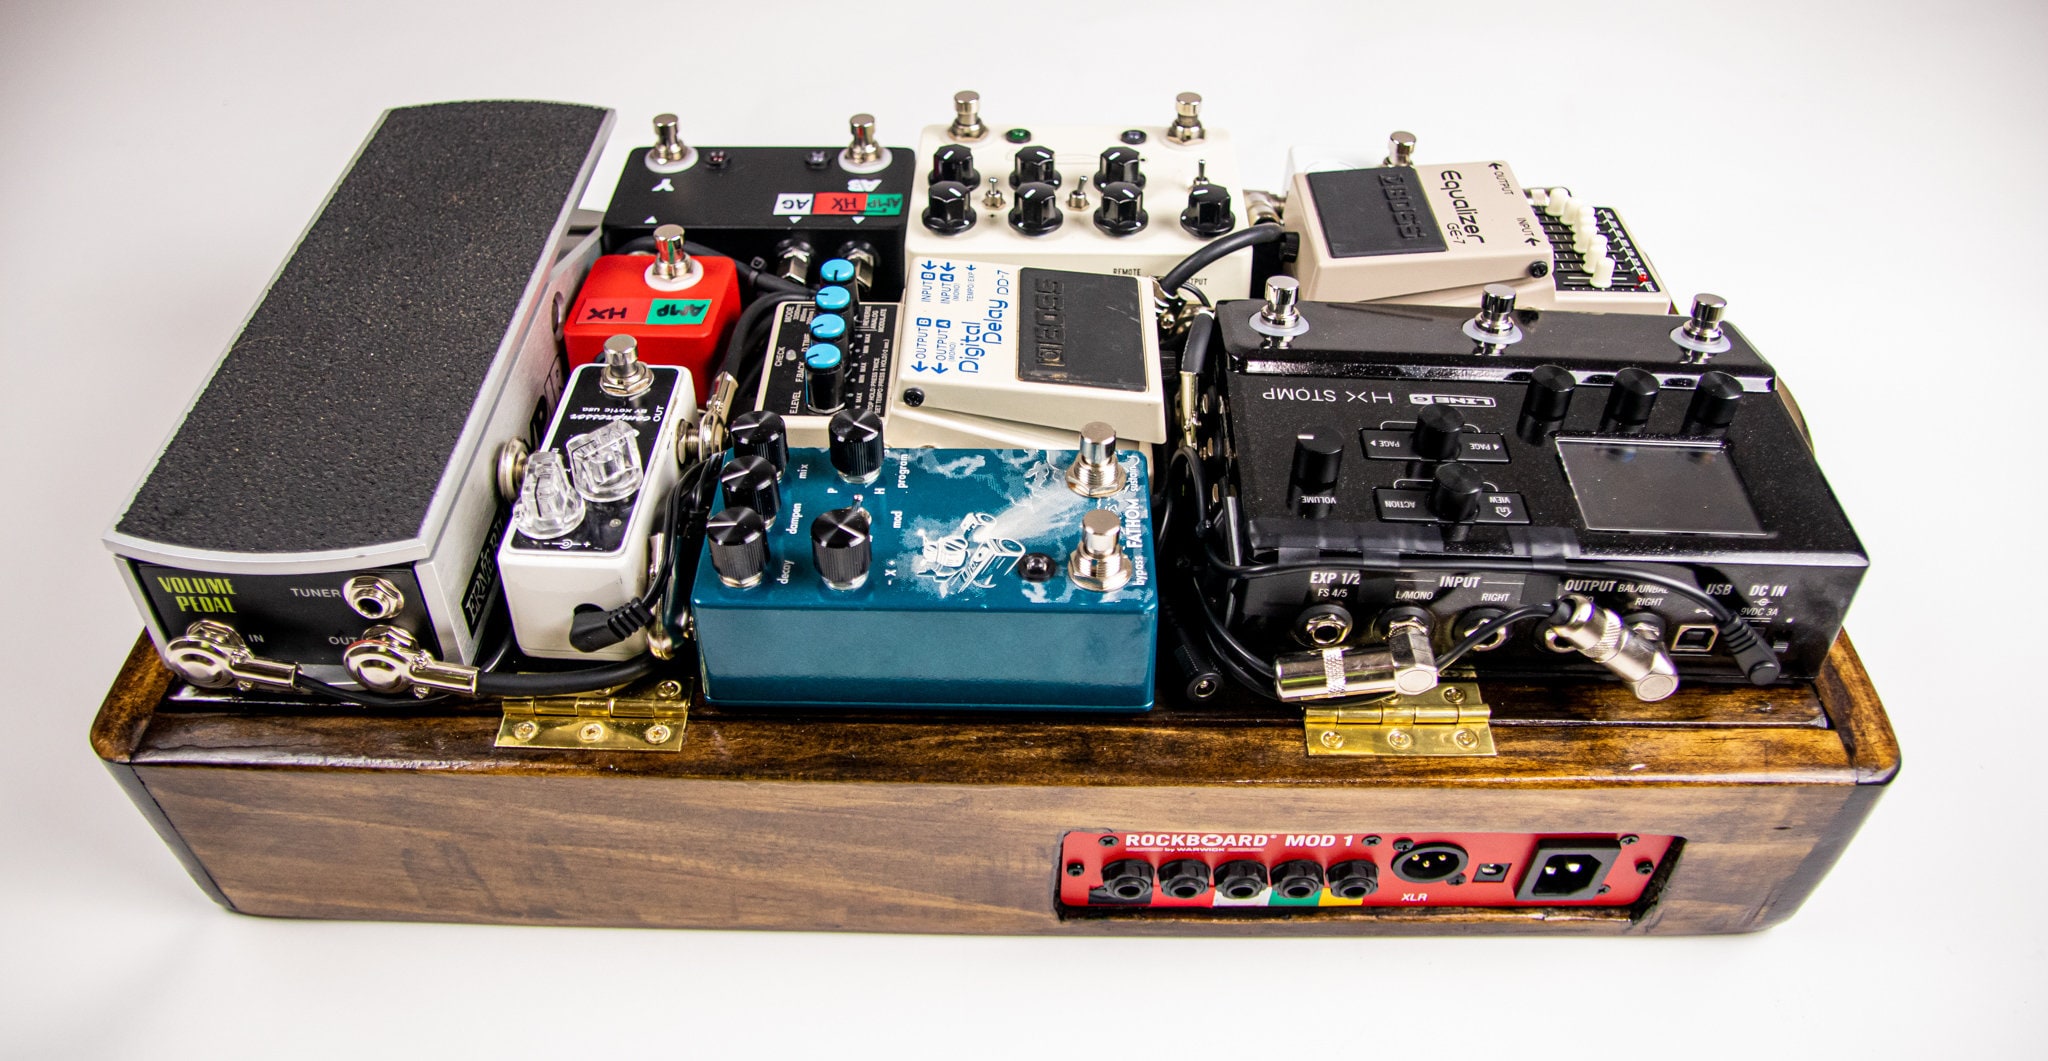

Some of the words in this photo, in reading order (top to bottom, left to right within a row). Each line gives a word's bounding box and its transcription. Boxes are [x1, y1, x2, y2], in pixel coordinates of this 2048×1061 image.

[651, 178, 675, 192] Y
[847, 178, 882, 192] AB
[1493, 170, 1514, 196] OUTPUT
[782, 198, 811, 210] AG
[831, 197, 858, 210] HX
[867, 197, 901, 209] AMP
[1440, 169, 1486, 245] Equalizer
[1446, 221, 1466, 245] GE-7
[1516, 216, 1535, 238] INPUT
[1112, 268, 1142, 276] REMOTE
[997, 269, 1010, 296] DD-7
[920, 281, 933, 303] INPUT
[940, 282, 952, 305] INPUT
[586, 307, 628, 321] HX
[656, 303, 707, 317] AMP
[982, 298, 1009, 345] Delay
[1036, 278, 1066, 367] BOSS
[915, 327, 929, 360] OUTPUT
[935, 329, 949, 362] OUTPUT
[958, 321, 986, 374] Digital
[774, 346, 786, 367] CHECK
[1262, 387, 1337, 402] STOMP
[1346, 391, 1393, 404] HX
[789, 390, 802, 415] E.LEVEL
[653, 405, 665, 422] OUT
[1379, 439, 1401, 448] PAGE
[1470, 442, 1491, 450] PAGE
[797, 463, 809, 480] mix
[897, 453, 909, 489] program
[874, 487, 886, 495] H
[1301, 495, 1337, 504] VOLUME
[1384, 500, 1416, 509] ACTION
[1489, 495, 1511, 504] VIEW
[786, 502, 802, 535] dampen
[891, 510, 903, 529] mod
[1125, 498, 1142, 549] FATHOM
[776, 559, 795, 585] decay
[1131, 555, 1146, 586] bypass
[1310, 571, 1337, 584] EXP
[1341, 572, 1361, 585] 1/2
[1439, 575, 1481, 588] INPUT
[156, 577, 237, 595] VOLUME
[1564, 579, 1618, 592] OUTPUT
[1705, 583, 1734, 596] USB
[1749, 585, 1770, 597] DC
[1770, 585, 1789, 597] IN
[290, 587, 341, 599] TUNER
[1318, 588, 1330, 598] FS
[1332, 589, 1348, 599] 4/5
[1395, 591, 1434, 601] L/MONO
[1481, 593, 1511, 603] RIGHT
[175, 597, 237, 614] PEDAL
[1634, 597, 1664, 607] RIGHT
[1740, 607, 1765, 616] 9VDC
[1766, 608, 1779, 616] 3A
[248, 634, 264, 643] IN
[328, 635, 358, 647] OUT
[1125, 834, 1268, 848] ROCKBOARD
[1285, 834, 1336, 848] MOD
[1343, 835, 1354, 847] 1
[1401, 893, 1428, 902] XLR
